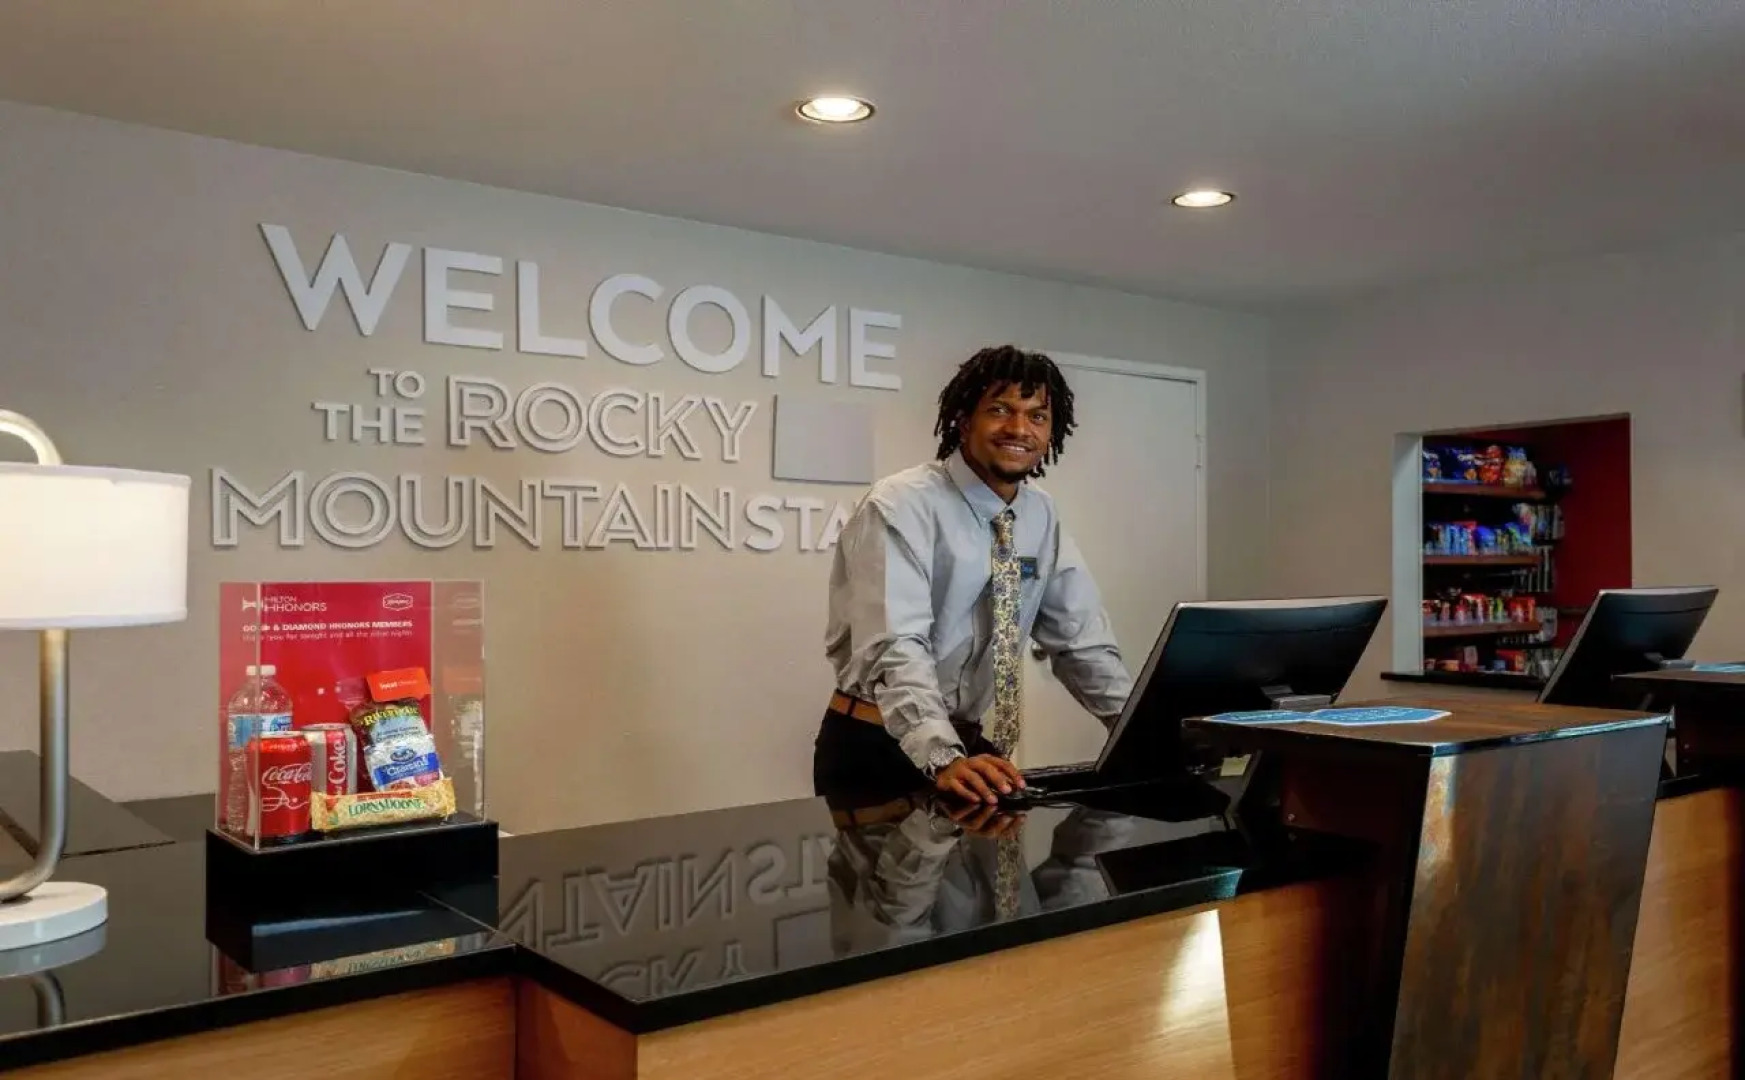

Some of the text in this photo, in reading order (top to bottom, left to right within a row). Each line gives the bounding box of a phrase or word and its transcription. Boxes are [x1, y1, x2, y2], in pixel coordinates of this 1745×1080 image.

[258, 223, 901, 390] WELCOME
[369, 368, 425, 399] TO
[312, 374, 758, 462] THE ROCKY
[210, 467, 849, 552] MOUNTAIN STA
[283, 622, 326, 631] DIAMOND
[328, 739, 346, 784] Coke
